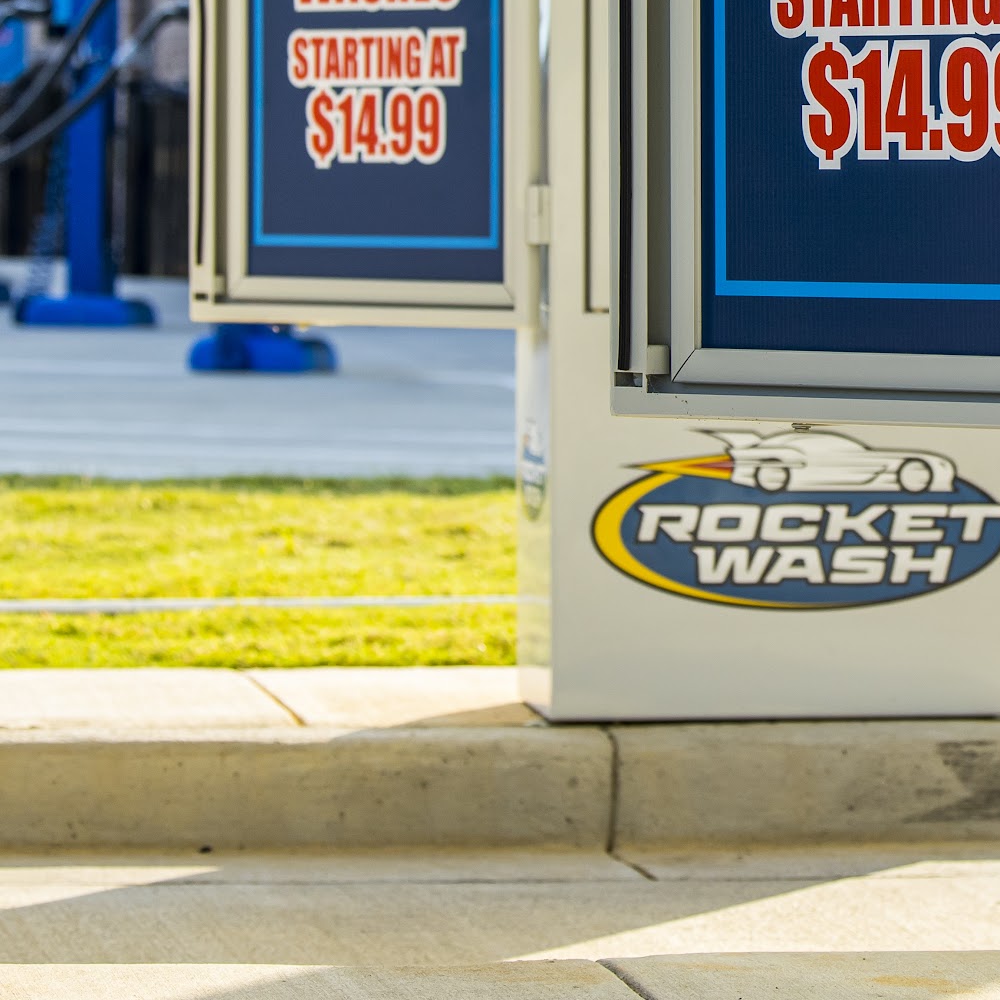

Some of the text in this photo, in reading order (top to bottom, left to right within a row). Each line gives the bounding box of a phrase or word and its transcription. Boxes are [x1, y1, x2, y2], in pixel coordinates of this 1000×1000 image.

[290, 32, 463, 84] STARTING AT
[308, 89, 443, 164] $14.99
[692, 546, 954, 585] WASH
